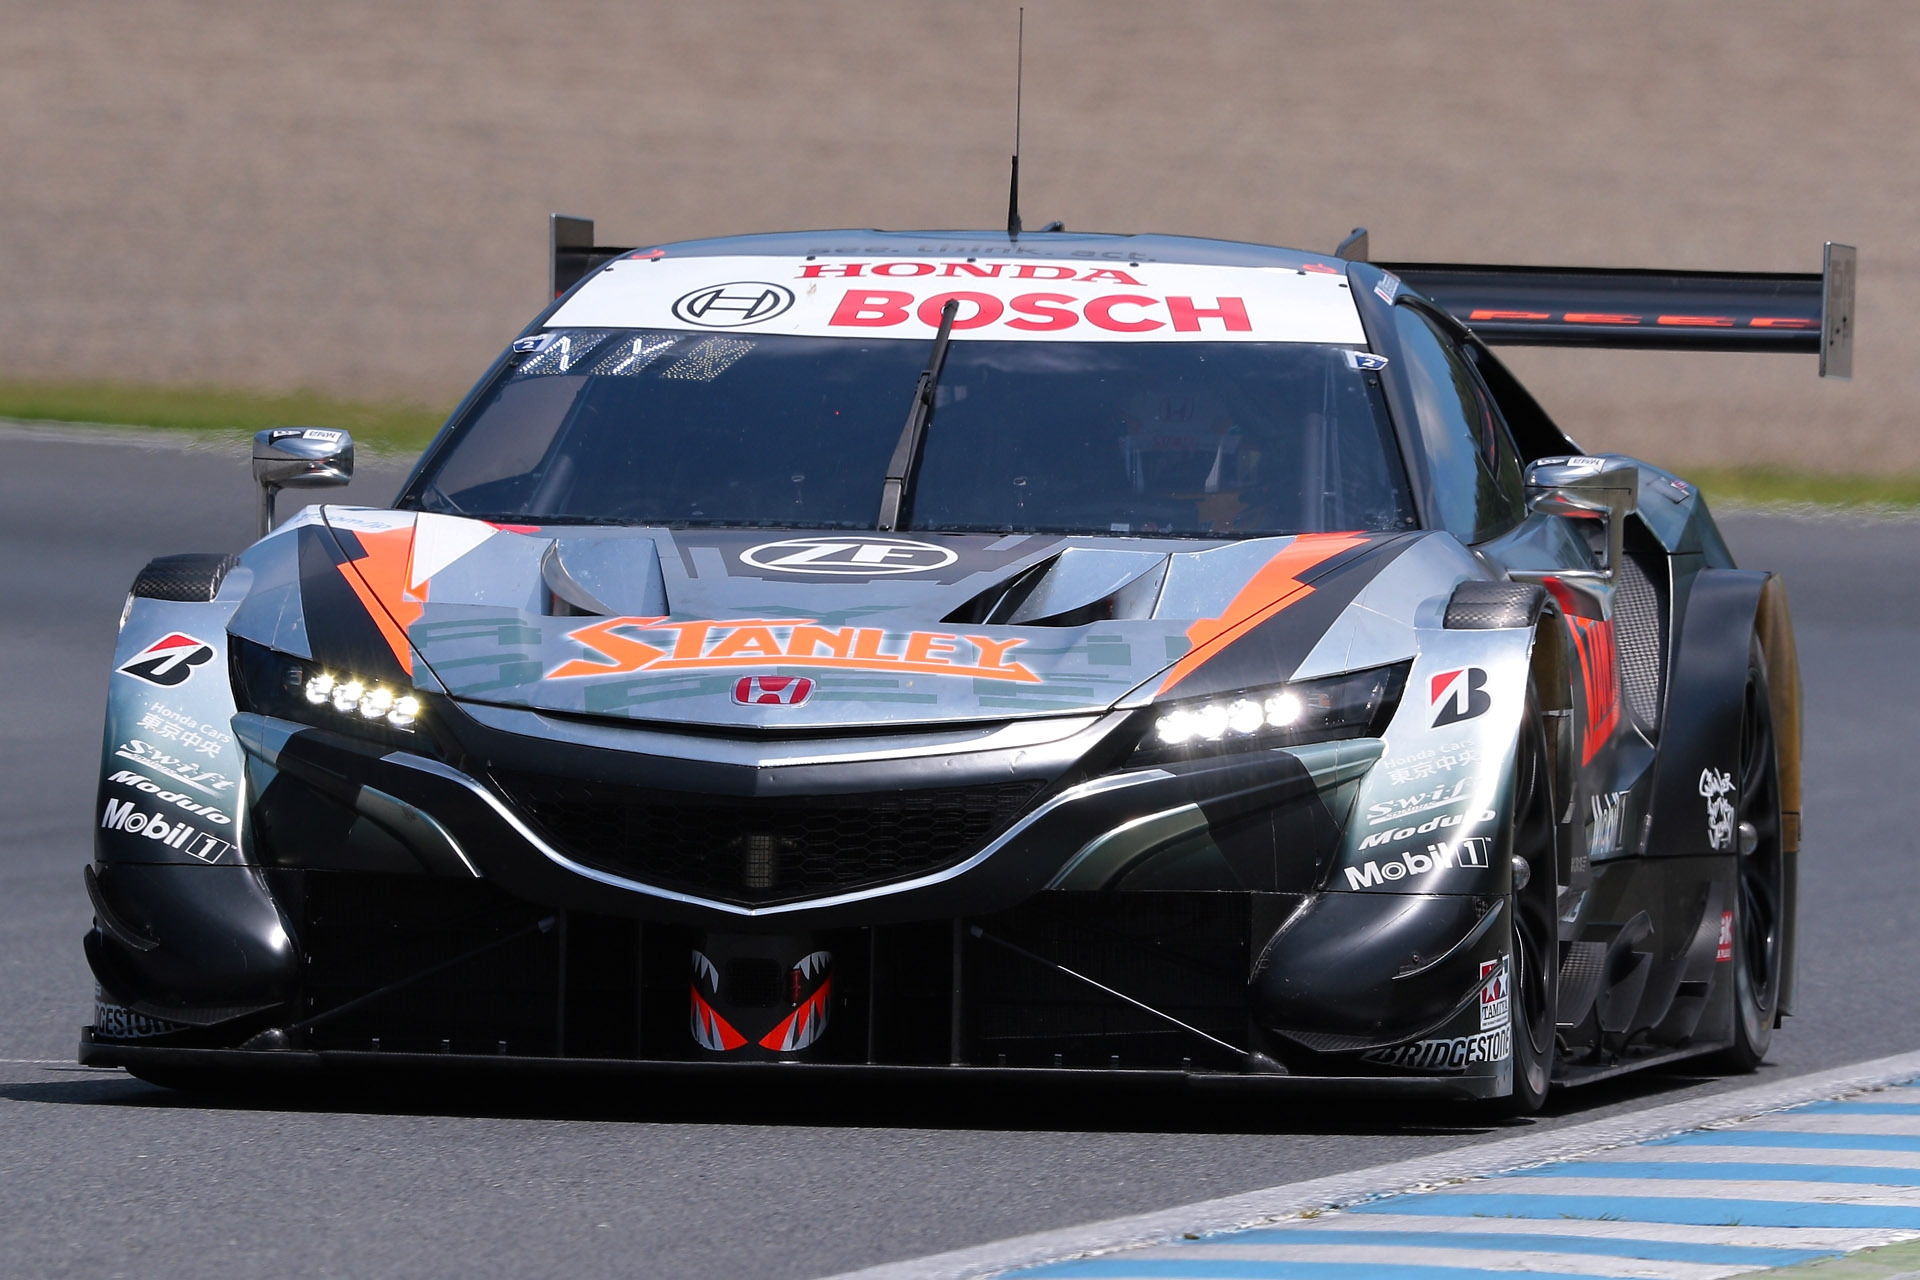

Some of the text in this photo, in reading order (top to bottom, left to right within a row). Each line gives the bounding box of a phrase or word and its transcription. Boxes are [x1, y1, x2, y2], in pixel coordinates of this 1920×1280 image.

[794, 261, 1149, 287] HONDA
[828, 289, 1253, 333] BOSCH
[764, 542, 925, 568] ZF
[545, 615, 1042, 683] STANLEY
[137, 712, 222, 758] 東京中央
[151, 702, 232, 744] Honda Cars
[1384, 750, 1435, 769] Honda
[1387, 750, 1481, 785] 東京中央
[108, 770, 232, 825] Modulo
[1367, 776, 1474, 820] Swif
[101, 798, 195, 849] Mobil
